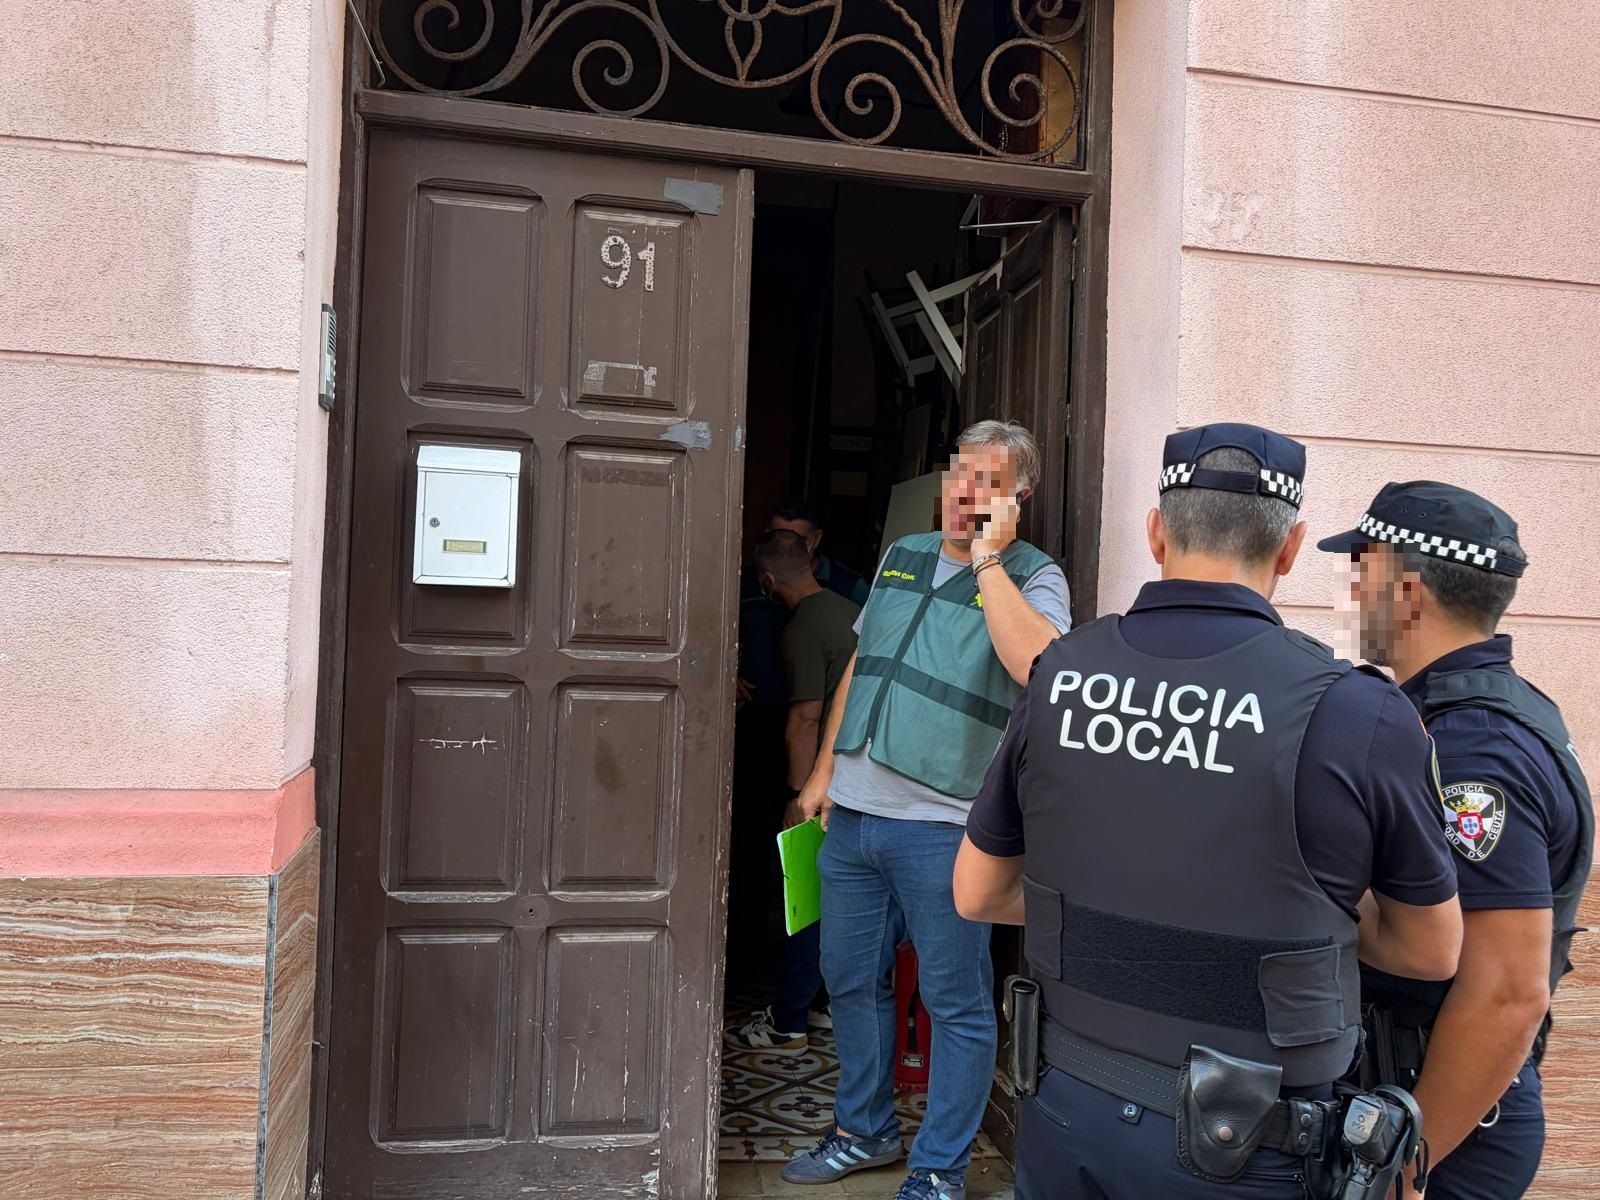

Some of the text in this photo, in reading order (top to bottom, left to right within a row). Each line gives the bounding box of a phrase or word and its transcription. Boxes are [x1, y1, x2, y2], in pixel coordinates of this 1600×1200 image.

[600, 235, 656, 292] 91
[1049, 670, 1265, 734] POLICIA
[1059, 708, 1234, 774] LOCAL
[1444, 785, 1485, 797] POLICIA
[1467, 849, 1485, 858] DE
[1488, 810, 1503, 840] CEUTA
